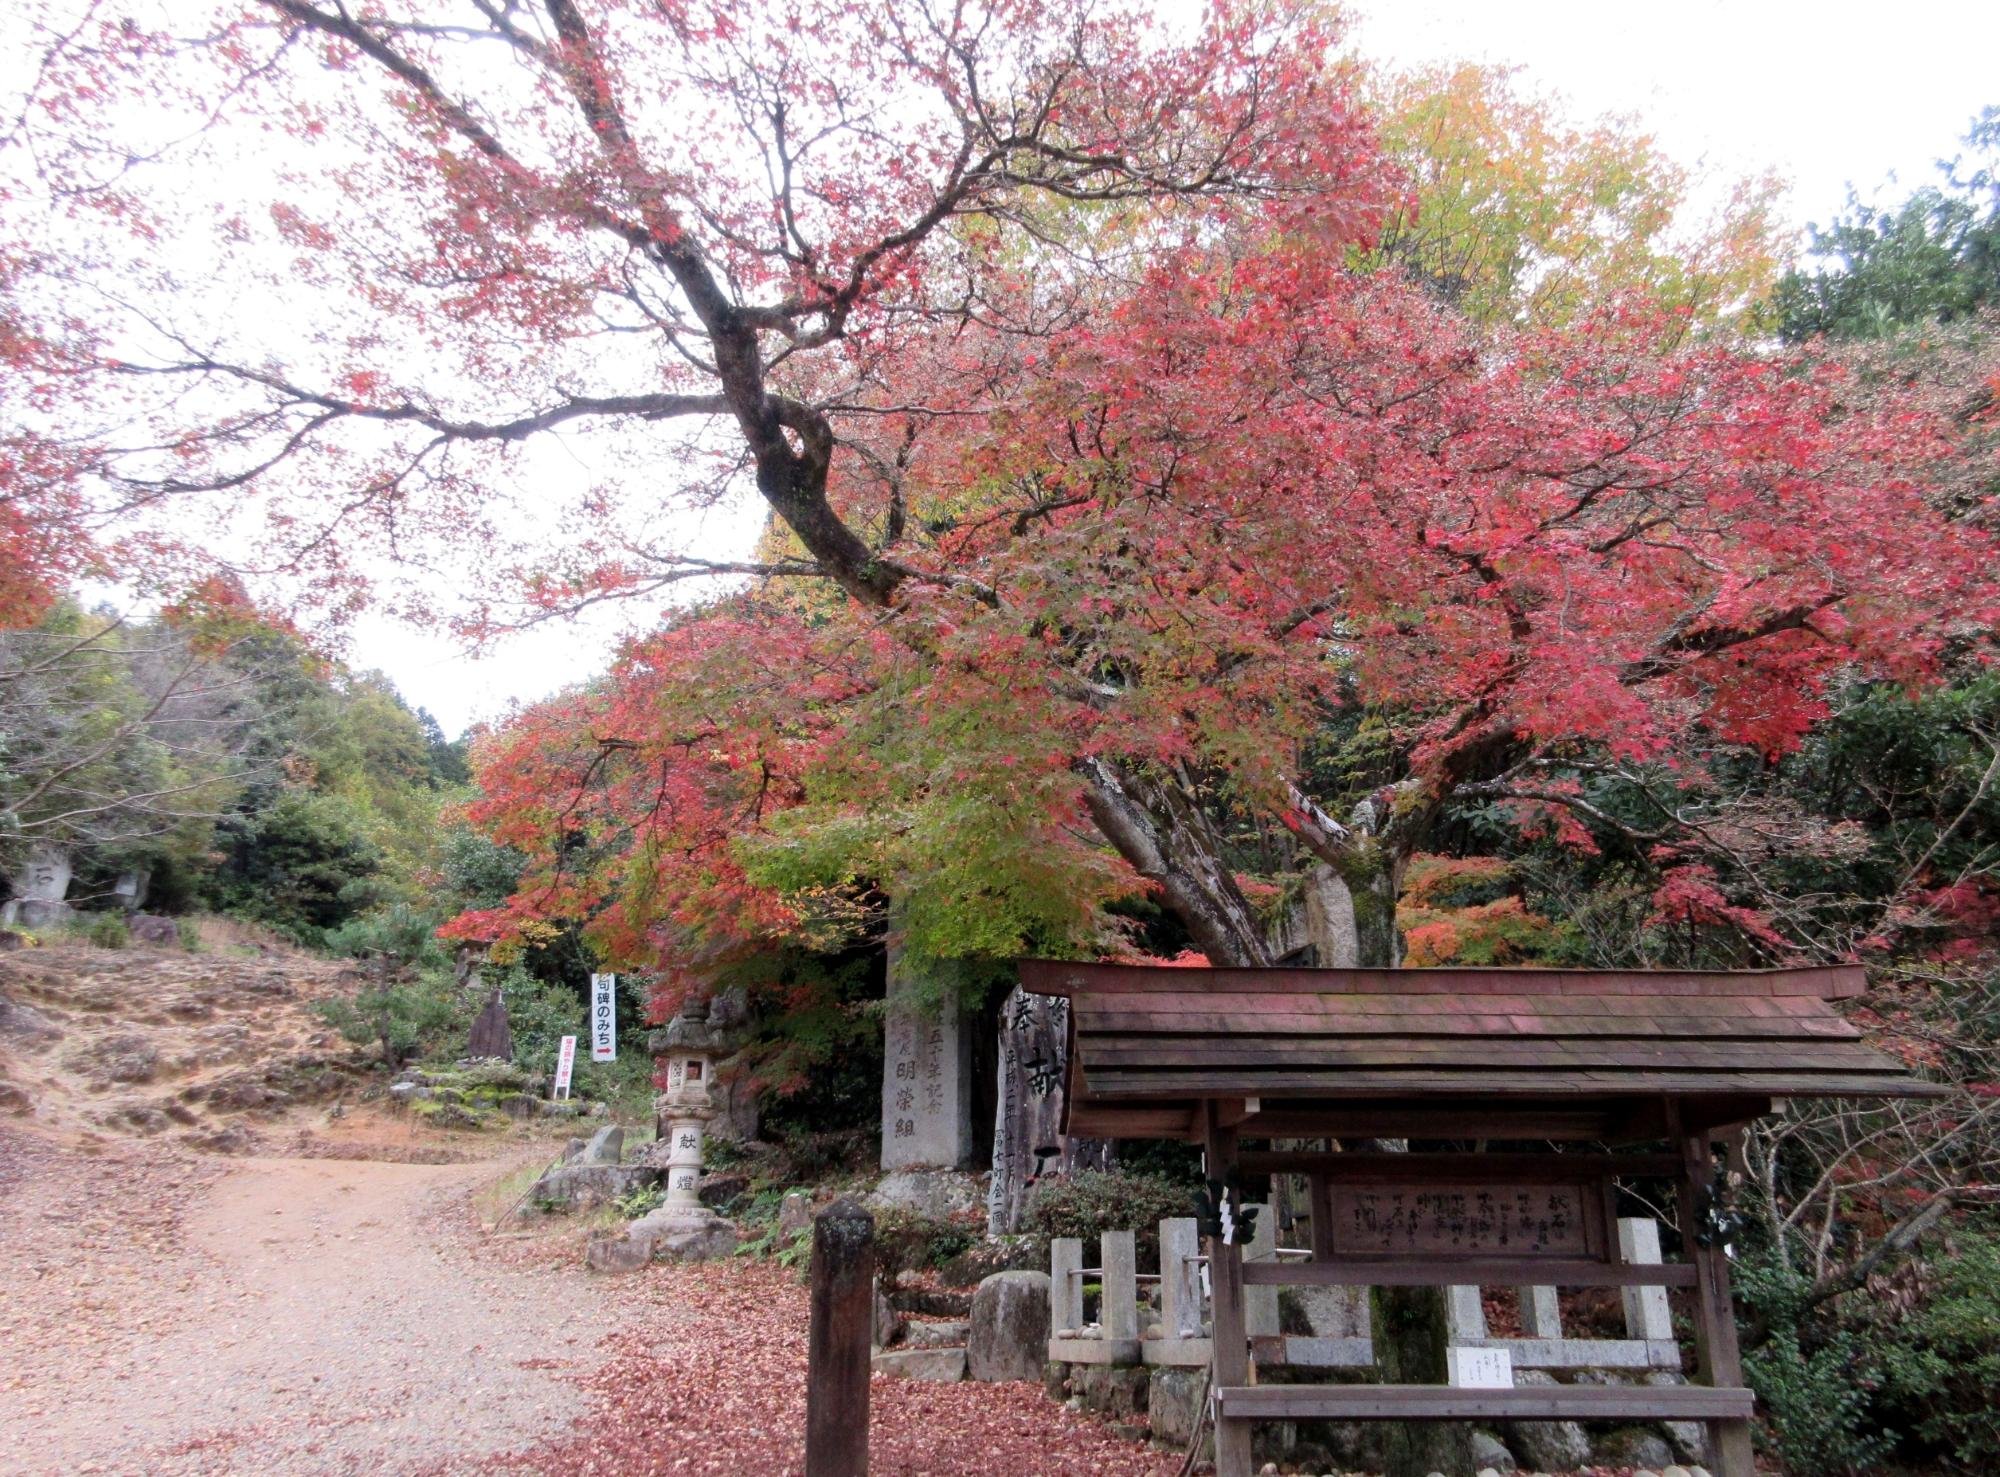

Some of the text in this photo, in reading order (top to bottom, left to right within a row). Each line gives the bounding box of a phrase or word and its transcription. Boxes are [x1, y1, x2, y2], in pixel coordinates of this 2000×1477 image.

[597, 974, 611, 1045] 句碑のみち
